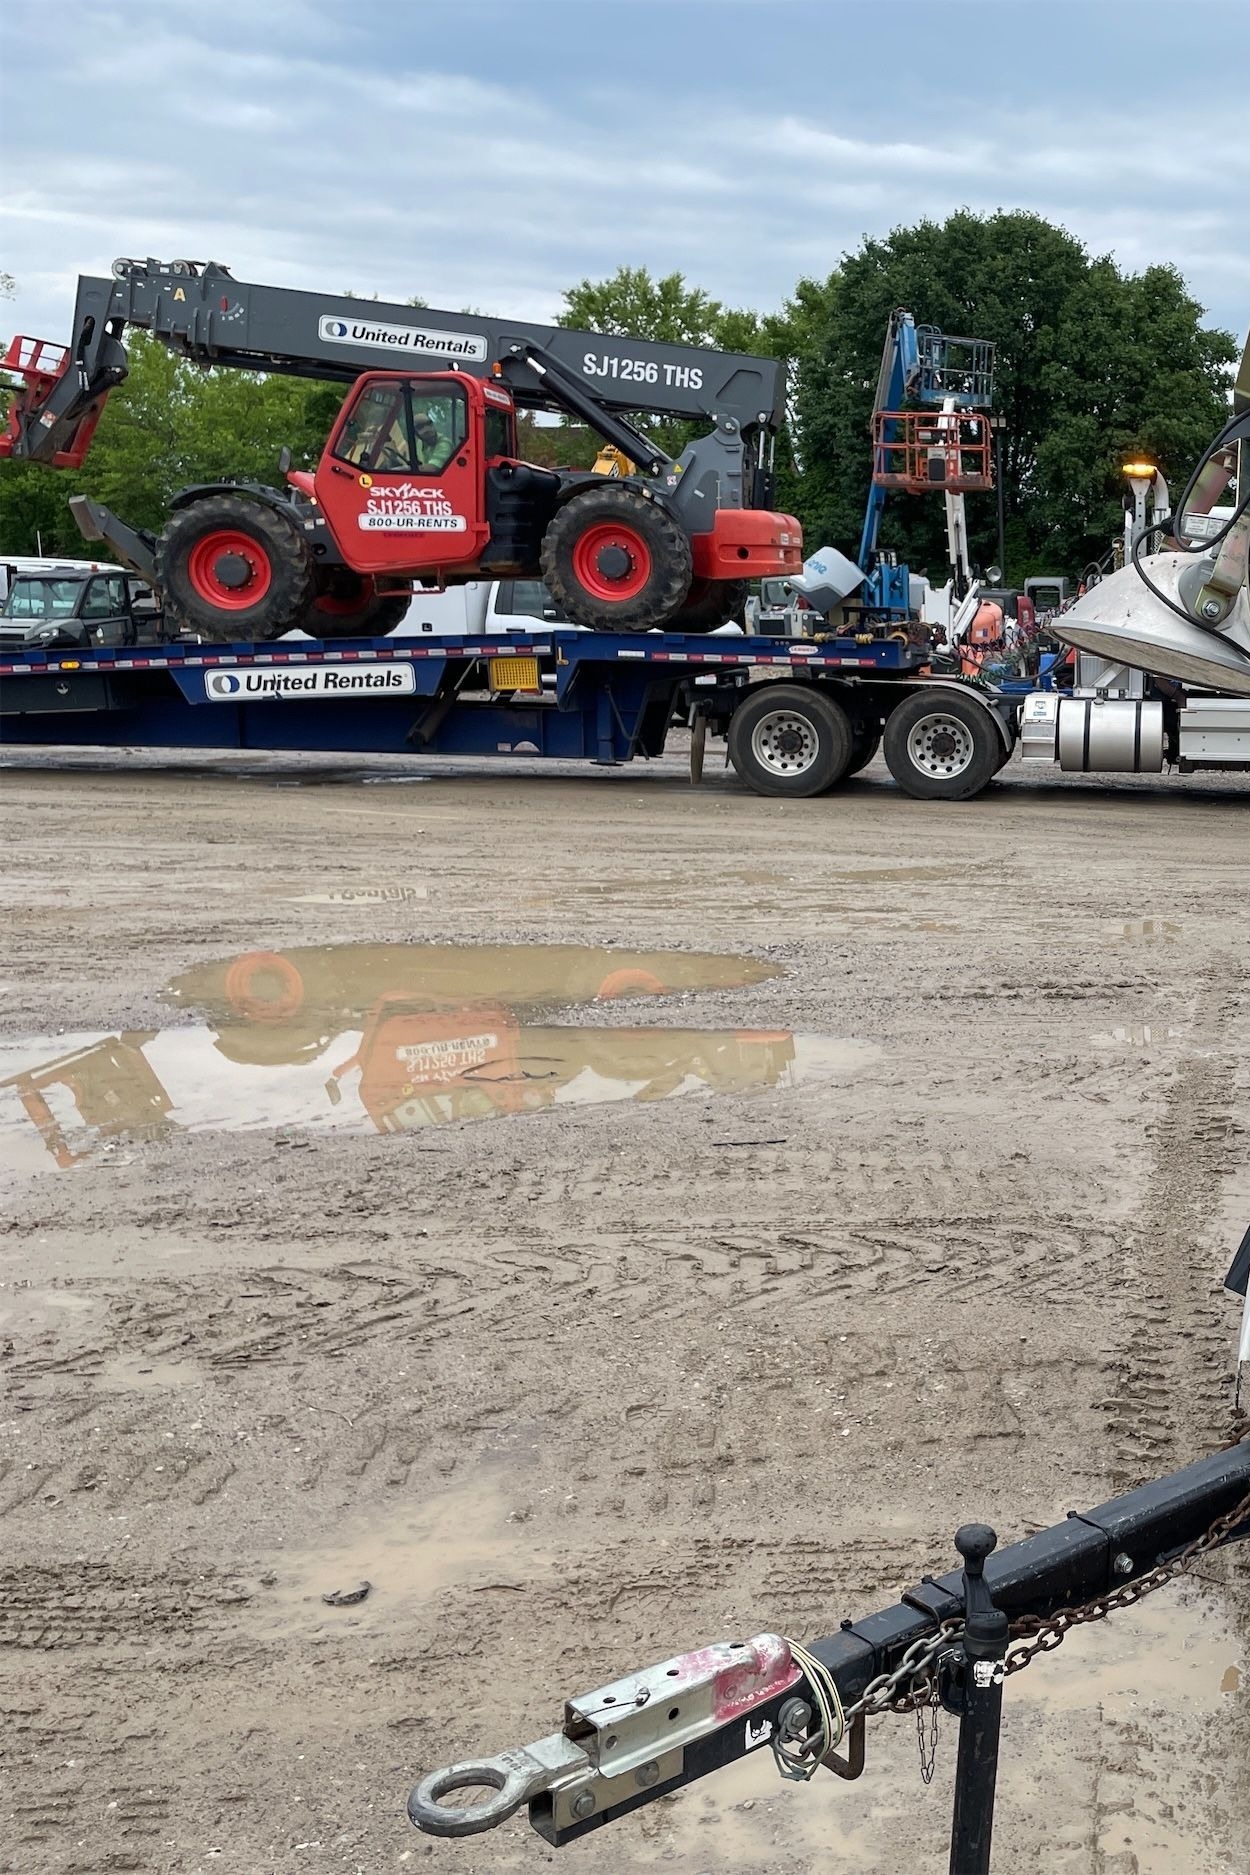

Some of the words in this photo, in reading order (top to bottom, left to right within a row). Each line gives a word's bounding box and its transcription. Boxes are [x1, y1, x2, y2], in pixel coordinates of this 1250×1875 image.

[173, 287, 186, 302] A
[351, 325, 409, 346] United
[413, 334, 477, 355] Rentals
[582, 353, 658, 384] SJ1256
[663, 364, 703, 390] THS
[361, 477, 370, 486] L
[369, 482, 446, 500] SKYJACK
[366, 499, 421, 515] SJ1256
[423, 500, 452, 516] THS
[368, 517, 458, 528] 800-UR-RENTS
[246, 672, 317, 692] United
[323, 670, 403, 689] Rentals
